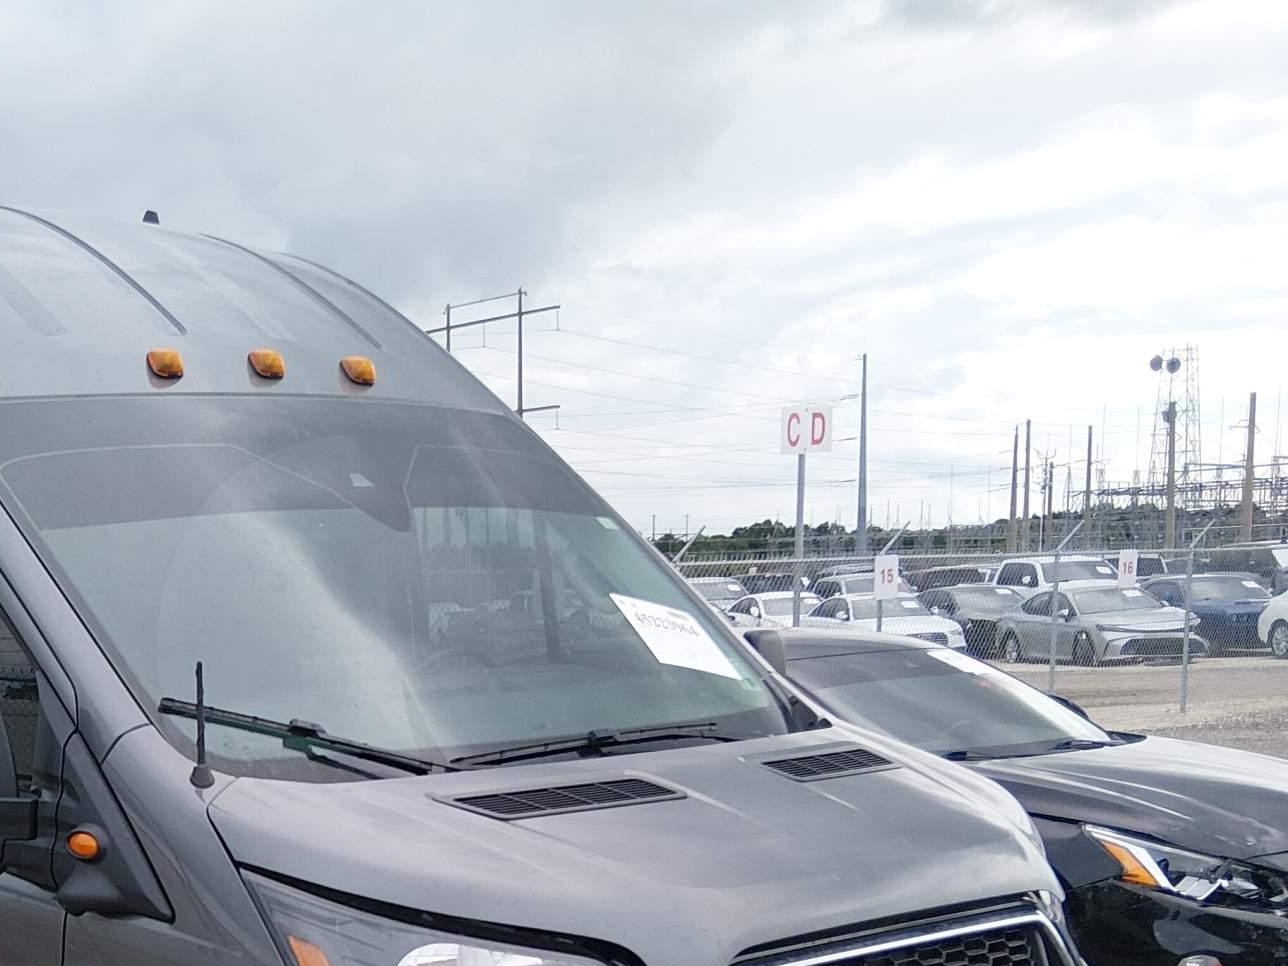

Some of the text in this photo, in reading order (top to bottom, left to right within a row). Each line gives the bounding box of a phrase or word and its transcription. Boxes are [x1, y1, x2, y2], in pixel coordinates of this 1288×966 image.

[787, 412, 825, 447] C D
[880, 568, 894, 584] 15
[1122, 561, 1133, 575] 16
